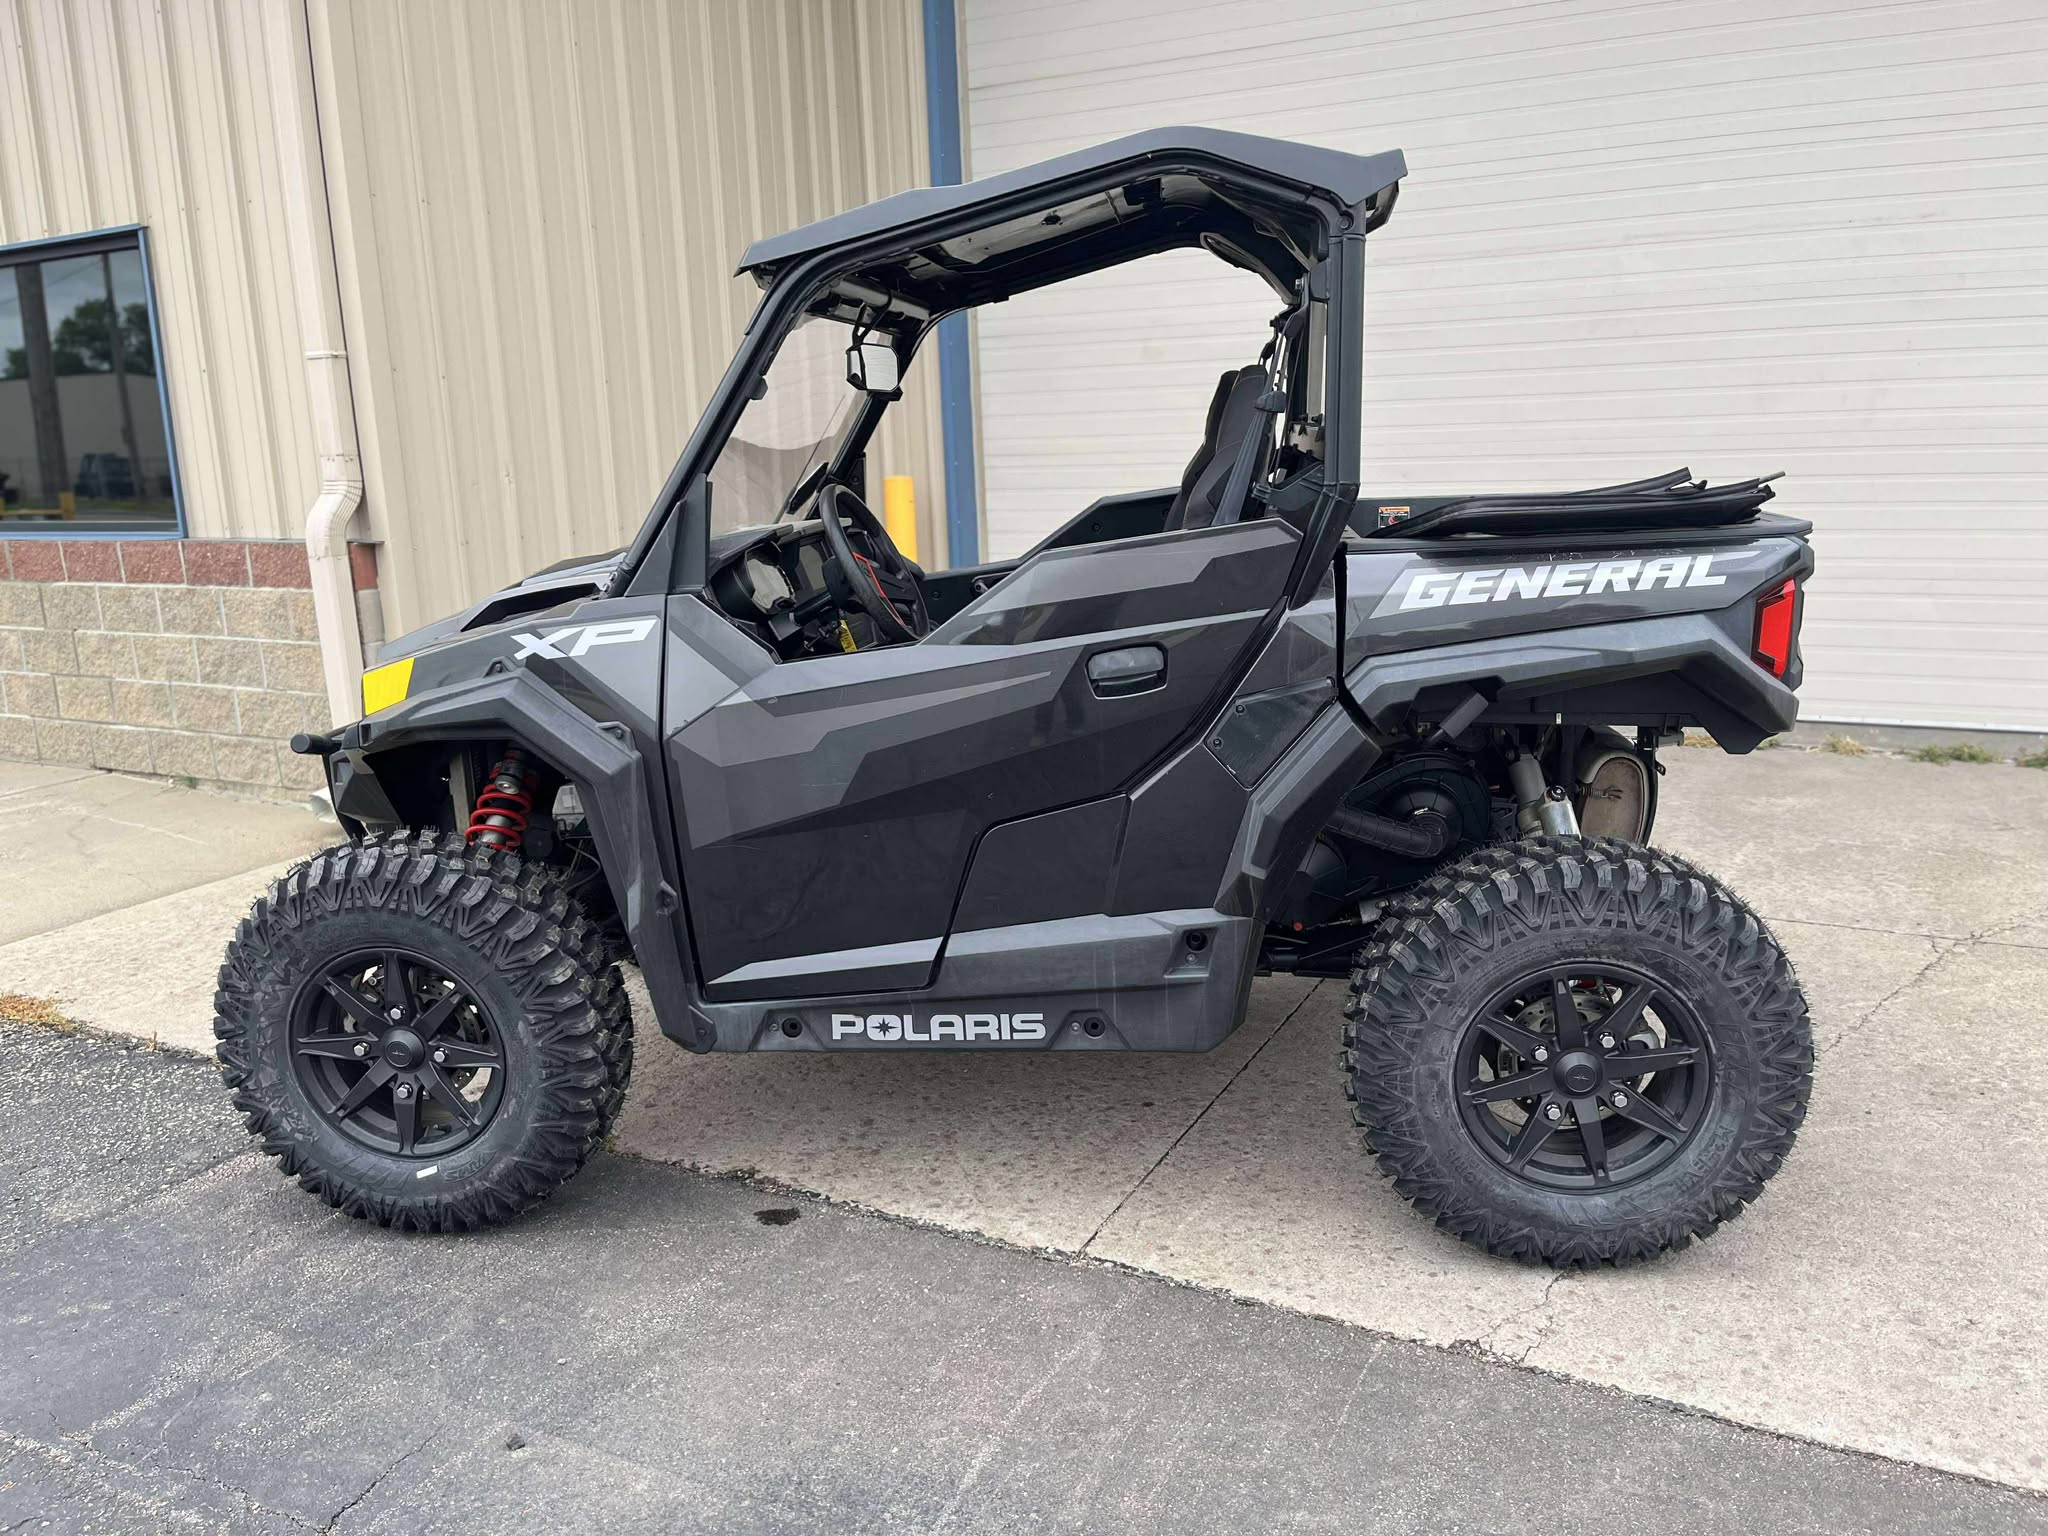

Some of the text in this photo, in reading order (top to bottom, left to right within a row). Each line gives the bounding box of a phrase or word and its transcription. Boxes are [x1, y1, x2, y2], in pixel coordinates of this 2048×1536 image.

[1400, 555, 1727, 609] GENERAL
[510, 619, 657, 660] XP
[831, 1013, 1046, 1041] POLARIS
